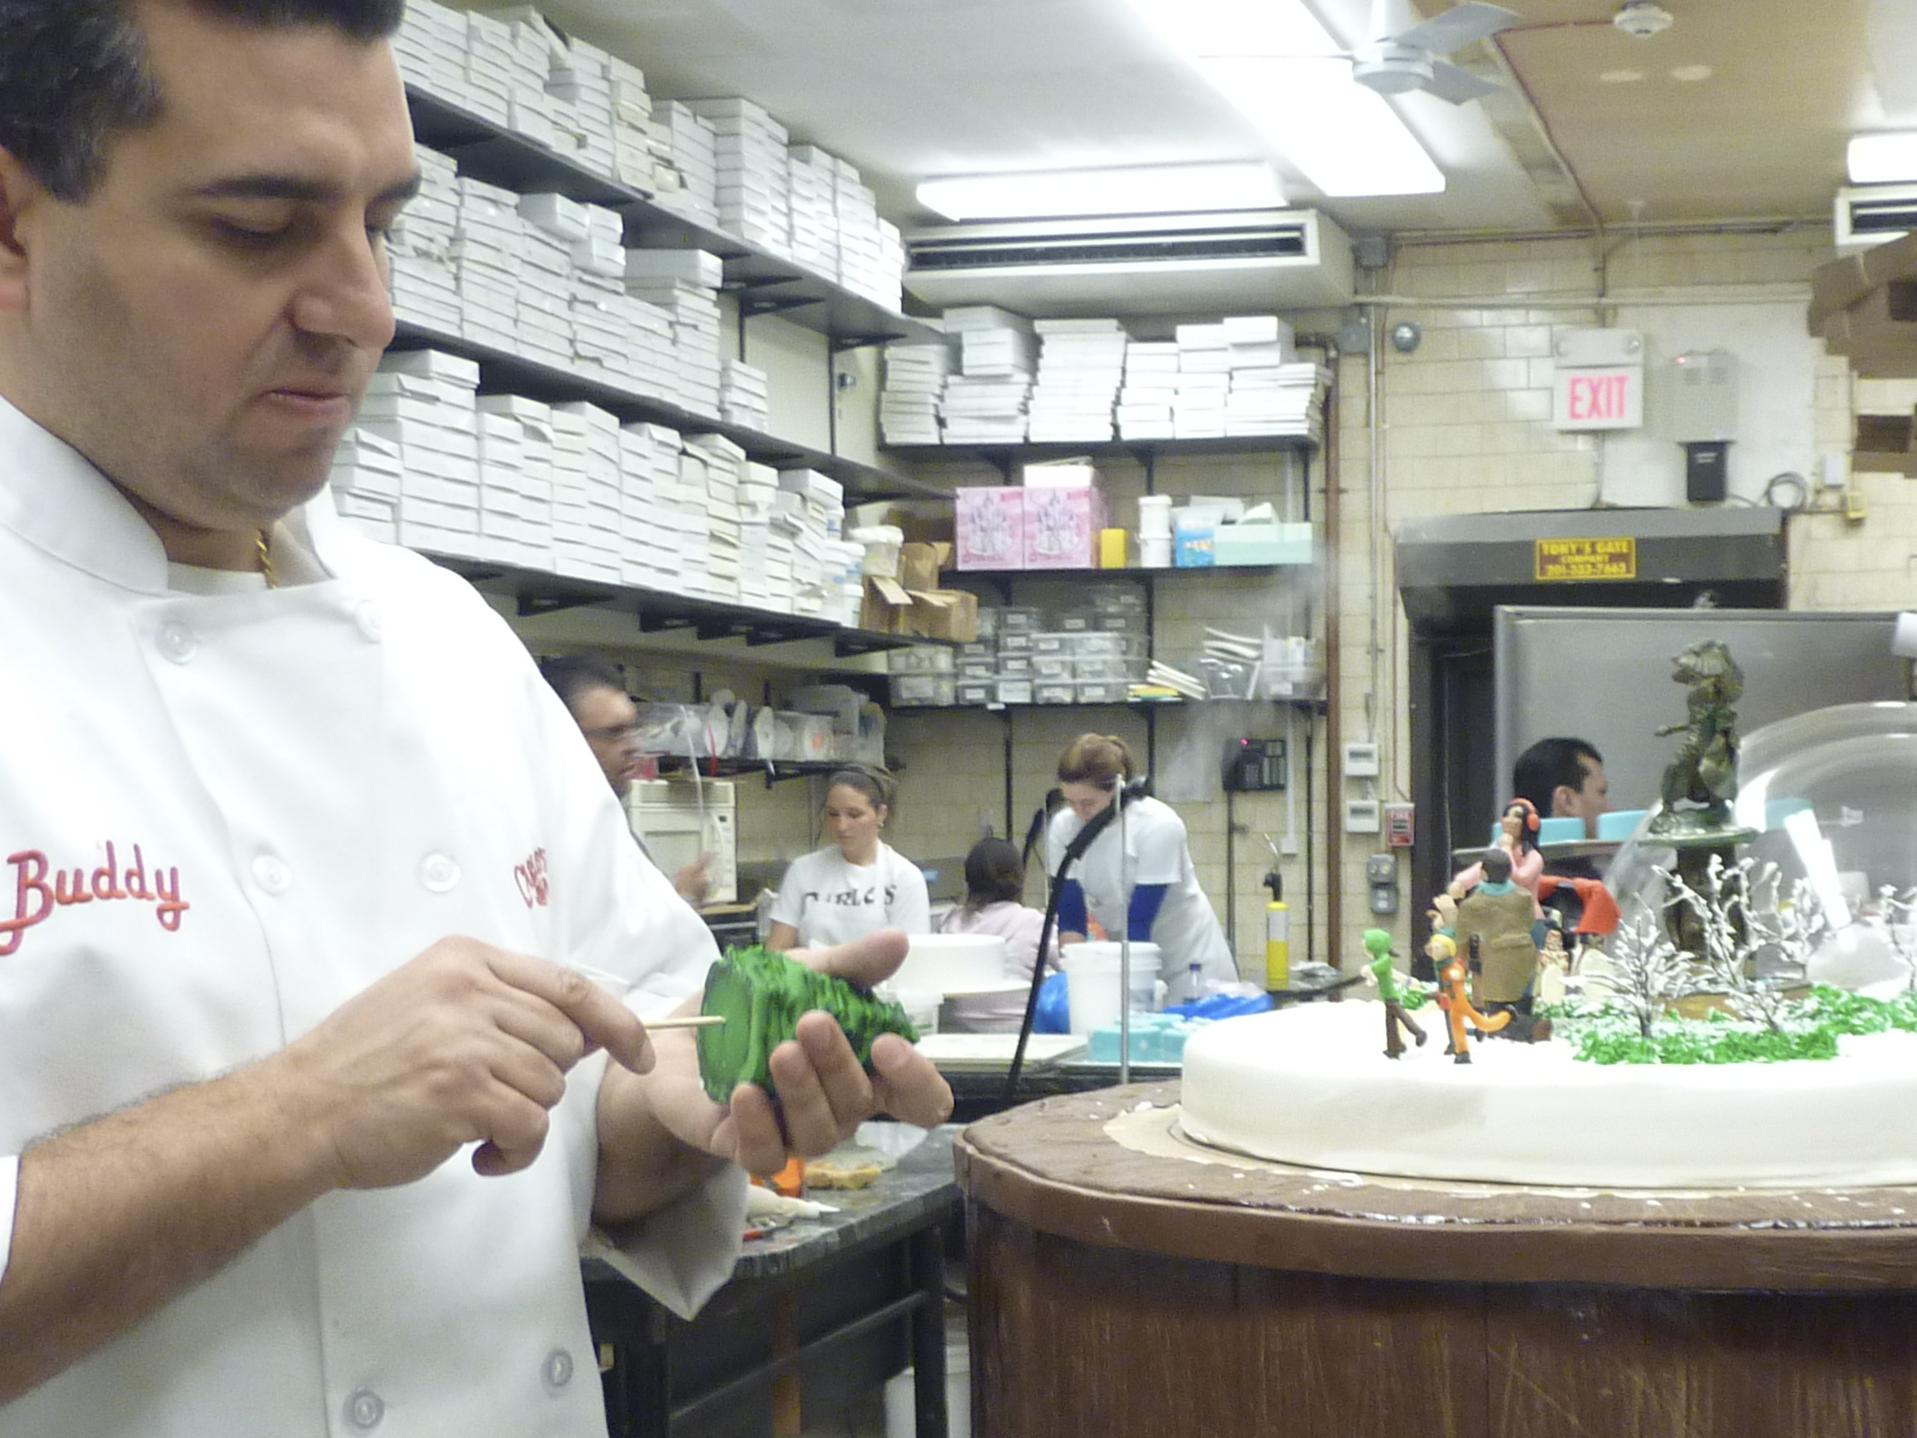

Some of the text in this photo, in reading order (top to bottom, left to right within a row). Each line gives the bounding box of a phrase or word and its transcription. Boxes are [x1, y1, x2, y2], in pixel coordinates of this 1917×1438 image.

[1568, 374, 1630, 420] EXIT
[1542, 541, 1629, 556] TONY'S GATE
[1561, 554, 1610, 564] COMPANY
[0, 840, 190, 957] Buddy
